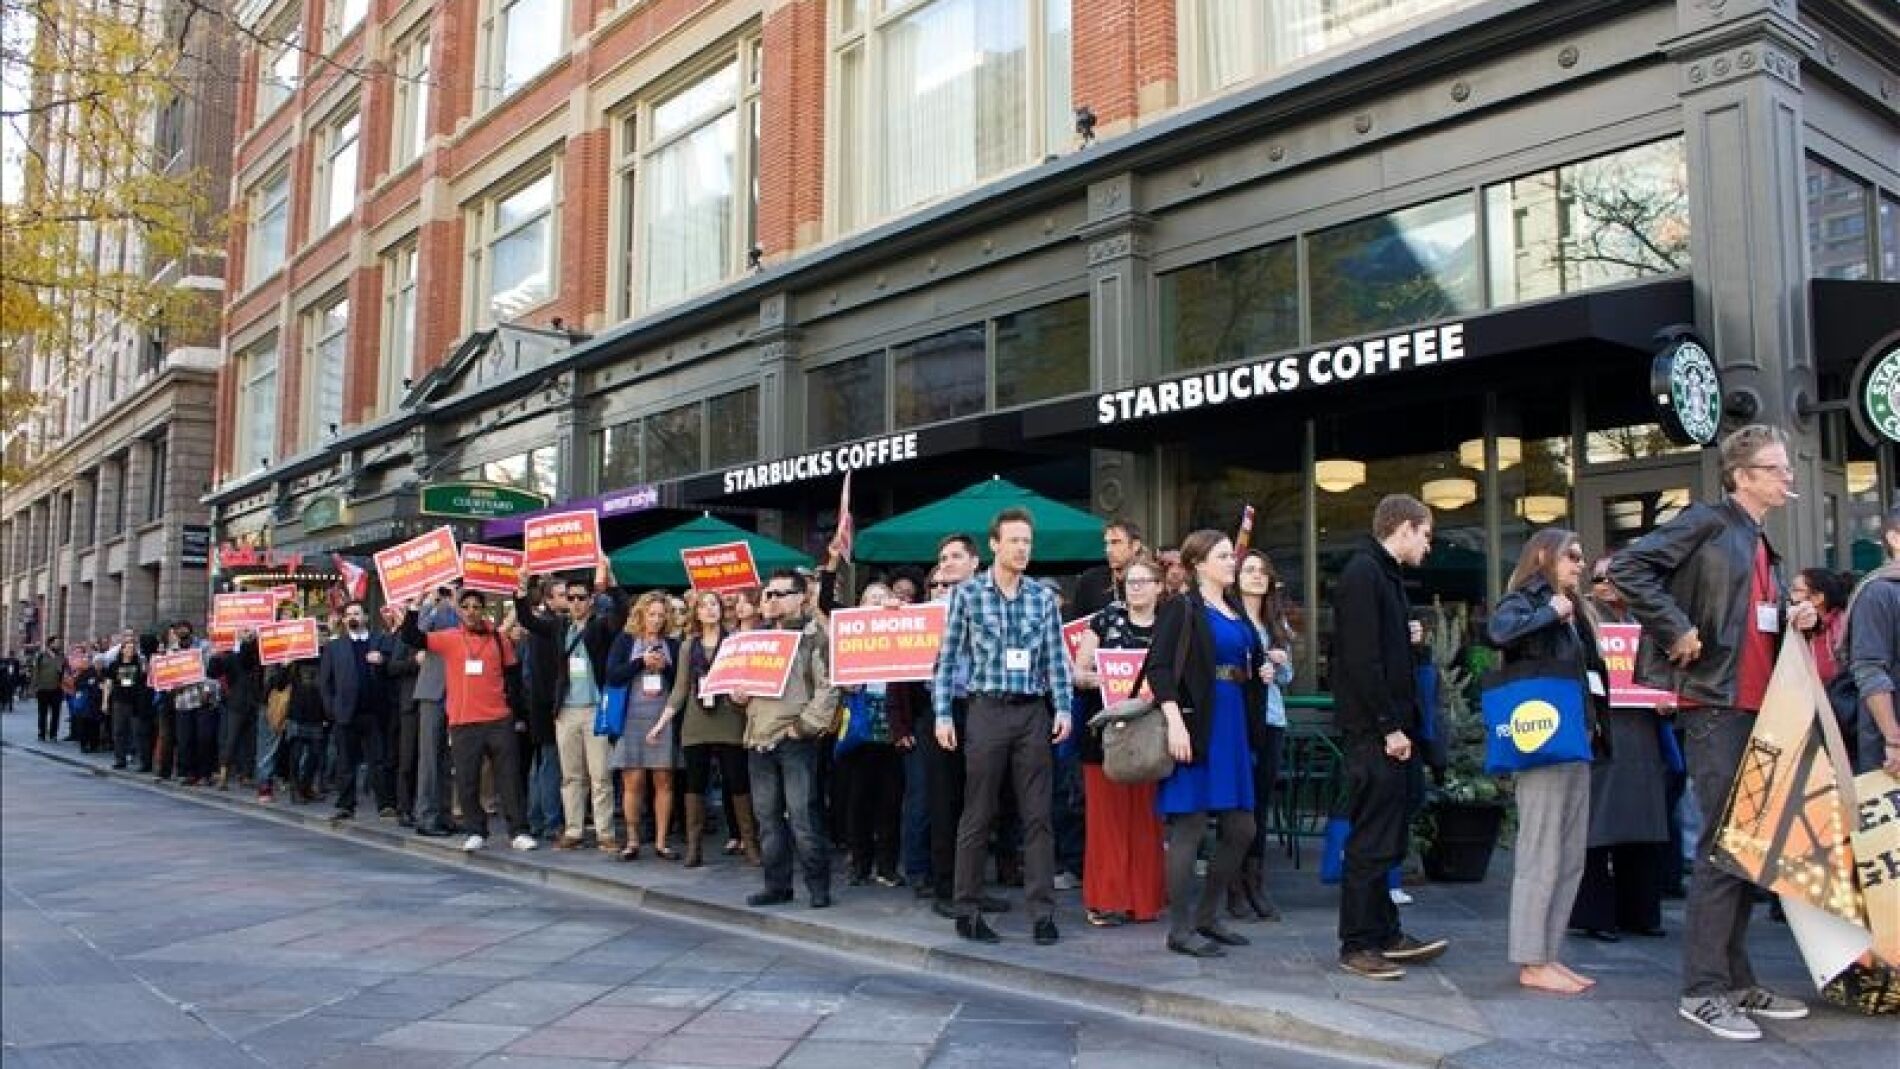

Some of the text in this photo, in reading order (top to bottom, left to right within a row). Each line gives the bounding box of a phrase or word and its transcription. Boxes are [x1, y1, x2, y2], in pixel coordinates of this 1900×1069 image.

[1097, 323, 1464, 424] STARBUCKS COFFEE
[723, 432, 917, 494] STARBUCKS COFFEE
[527, 519, 582, 538] NO MORE
[527, 532, 592, 551] DRUG WAR
[381, 539, 440, 568] NO MORE
[687, 551, 736, 566] NO MORE
[386, 546, 452, 581] DRUG WAR
[691, 561, 749, 579] DRUG WAR
[837, 616, 928, 635] NO MORE
[837, 633, 938, 654] DRUG WAR
[1105, 660, 1133, 676] NO
